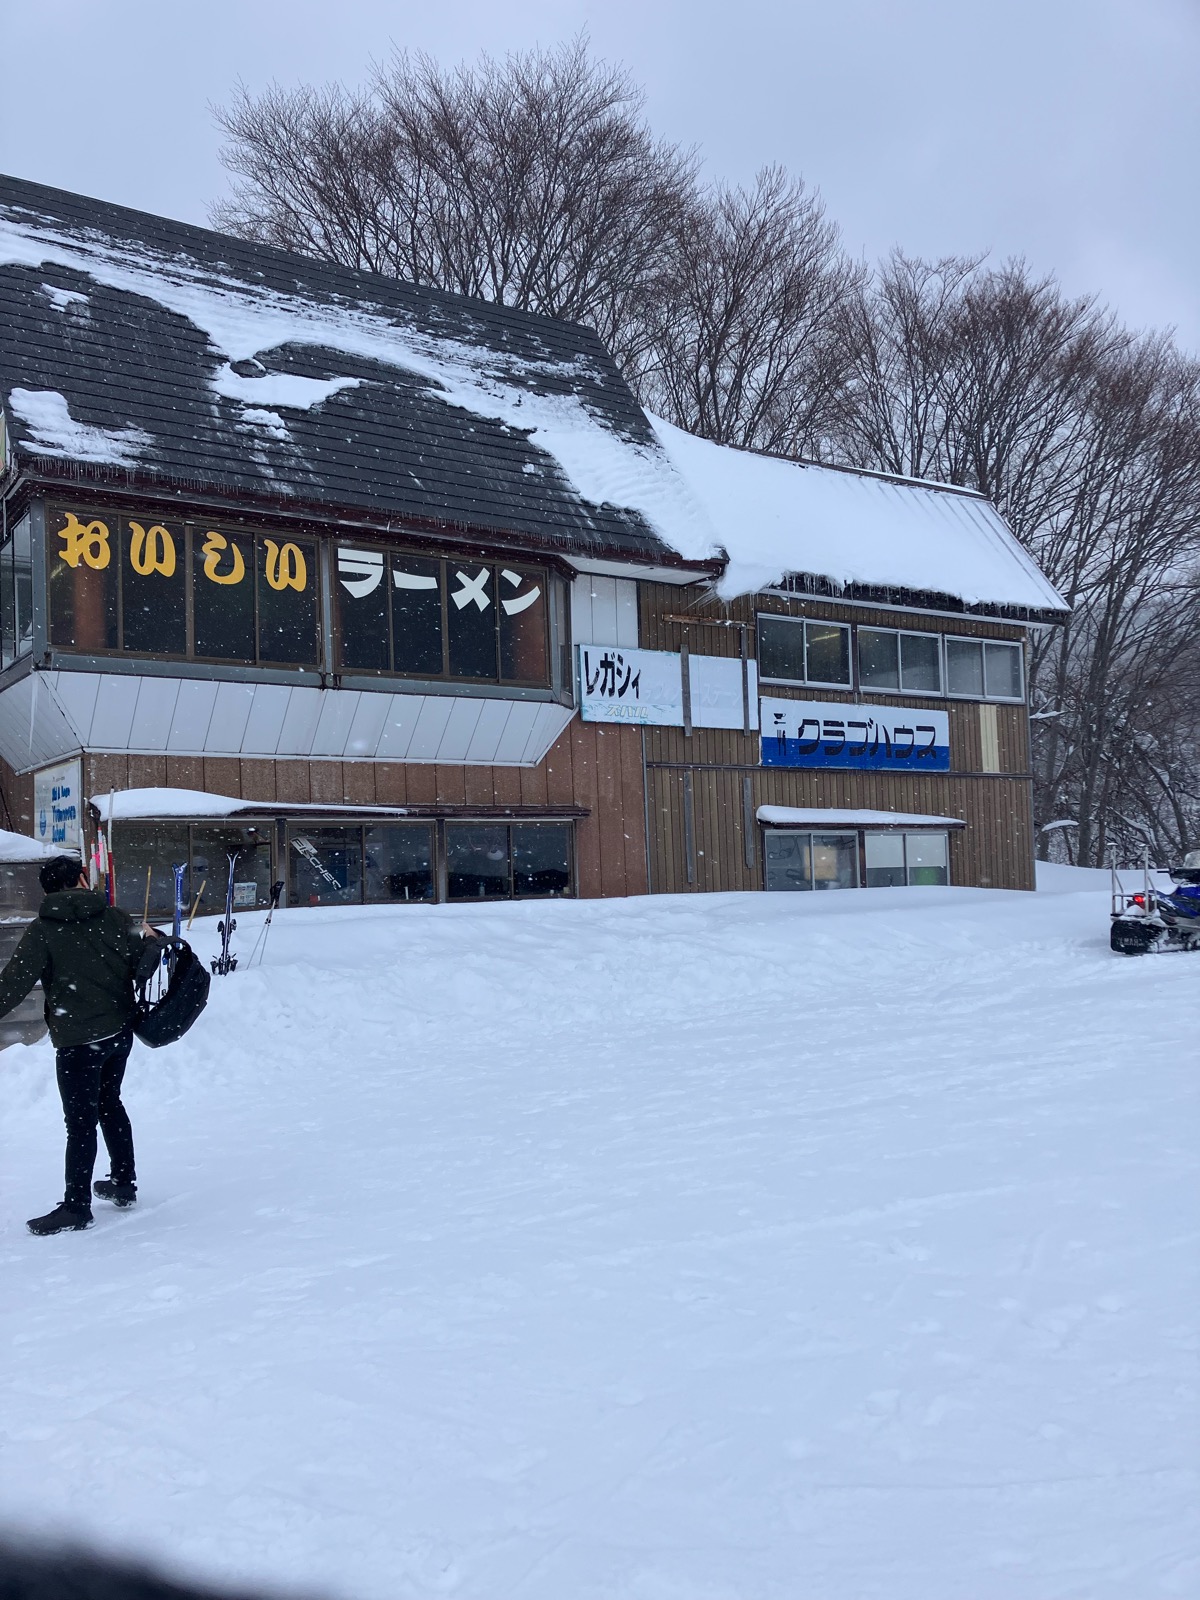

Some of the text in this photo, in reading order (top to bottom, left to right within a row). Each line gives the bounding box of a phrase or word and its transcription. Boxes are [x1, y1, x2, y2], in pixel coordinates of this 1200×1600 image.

[56, 512, 541, 615] おいしい ラーメン
[584, 650, 642, 700] レガシィ
[798, 718, 937, 759] クラブハウス
